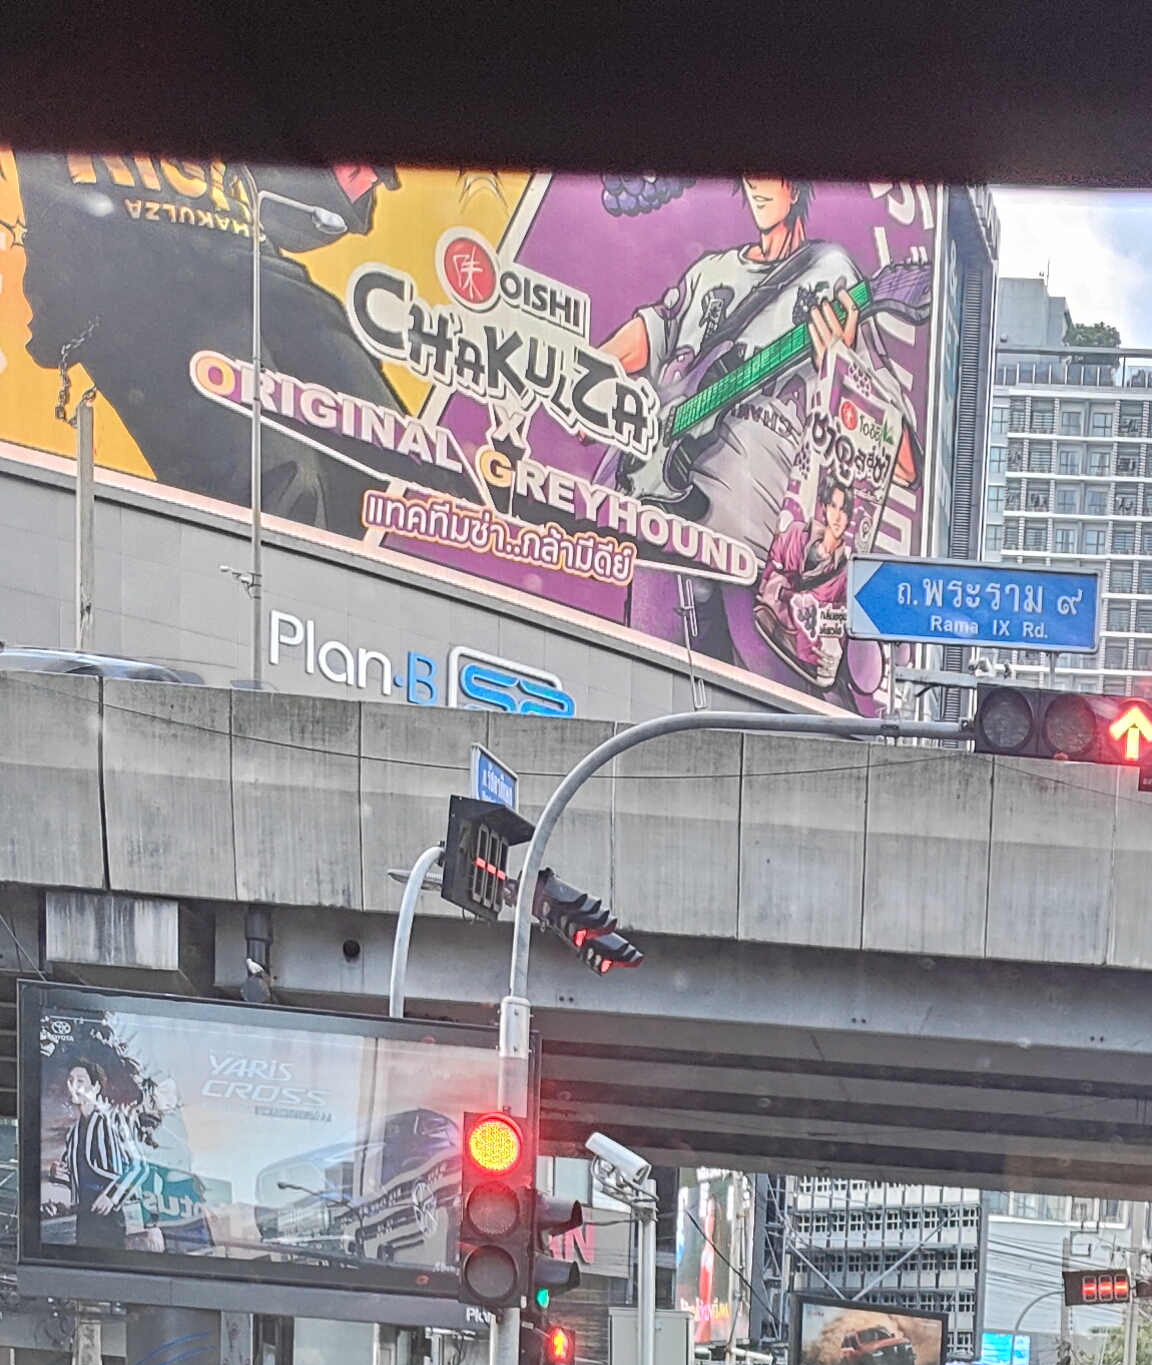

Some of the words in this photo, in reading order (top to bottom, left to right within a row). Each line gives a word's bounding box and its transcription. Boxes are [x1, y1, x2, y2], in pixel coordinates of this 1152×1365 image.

[500, 271, 580, 328] OISHI
[353, 271, 655, 445] CHAKULZA
[187, 360, 463, 473] ORIGINAL
[480, 449, 757, 578] GREYHOUND
[930, 614, 979, 636] Rama
[993, 619, 1010, 637] IX
[1022, 621, 1048, 640] Rd.
[202, 1078, 332, 1108] CROSS
